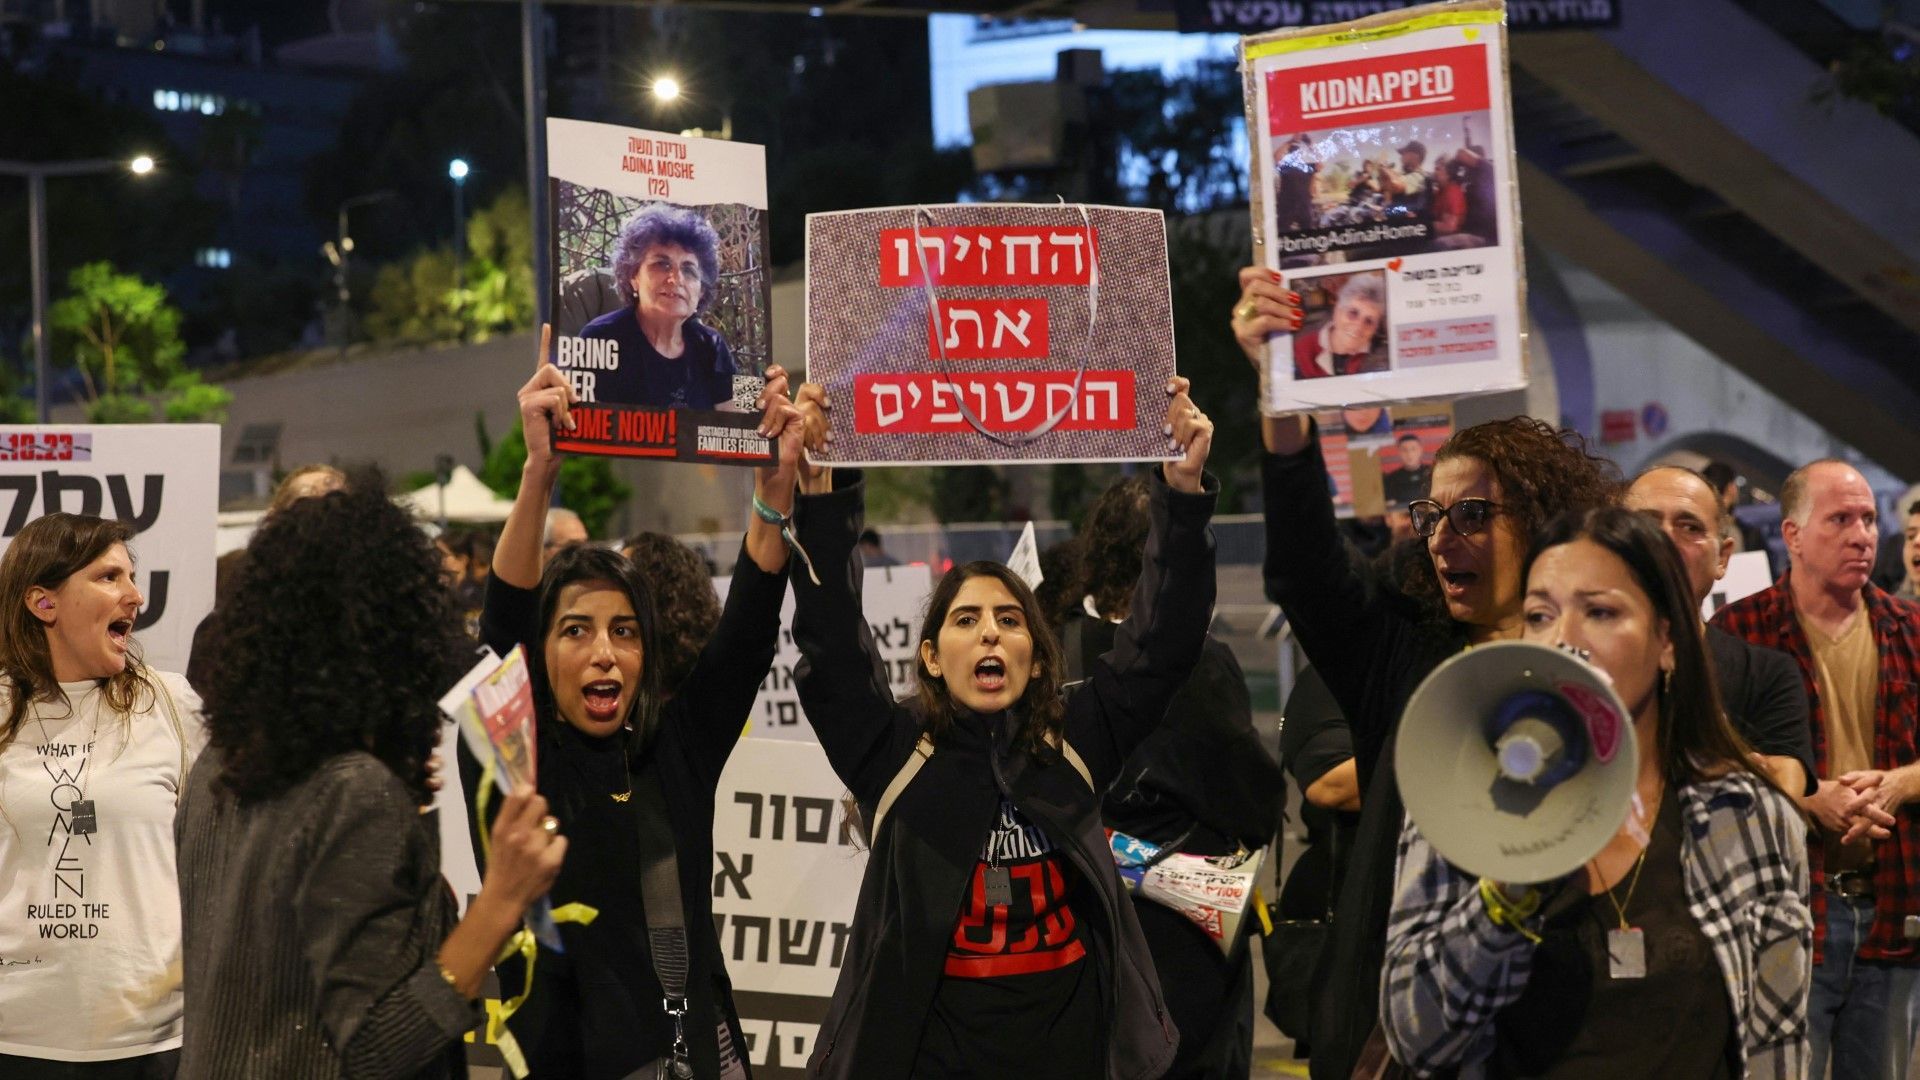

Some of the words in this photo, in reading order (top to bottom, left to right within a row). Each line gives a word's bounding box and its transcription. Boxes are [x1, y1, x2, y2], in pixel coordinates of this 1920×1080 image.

[1300, 65, 1454, 112] KIDNAPPED
[628, 136, 653, 156] משה
[656, 140, 687, 160] עדינה
[622, 155, 654, 175] ADINA
[657, 160, 695, 180] MOSHE
[647, 178, 670, 198] (72)
[894, 232, 1084, 277] החזירו
[945, 307, 1032, 350] את
[557, 336, 620, 371] BRING
[870, 379, 1119, 428] החטופים
[557, 408, 613, 441] OME
[618, 409, 677, 445] NOW!
[0, 433, 73, 461] .10.23
[697, 436, 737, 453] FAMILIES
[738, 439, 770, 455] FORUM
[36, 743, 77, 758] WHAT
[82, 741, 96, 754] IF
[27, 904, 77, 920] RULED
[82, 904, 110, 919] THE
[39, 923, 99, 939] WORLD
